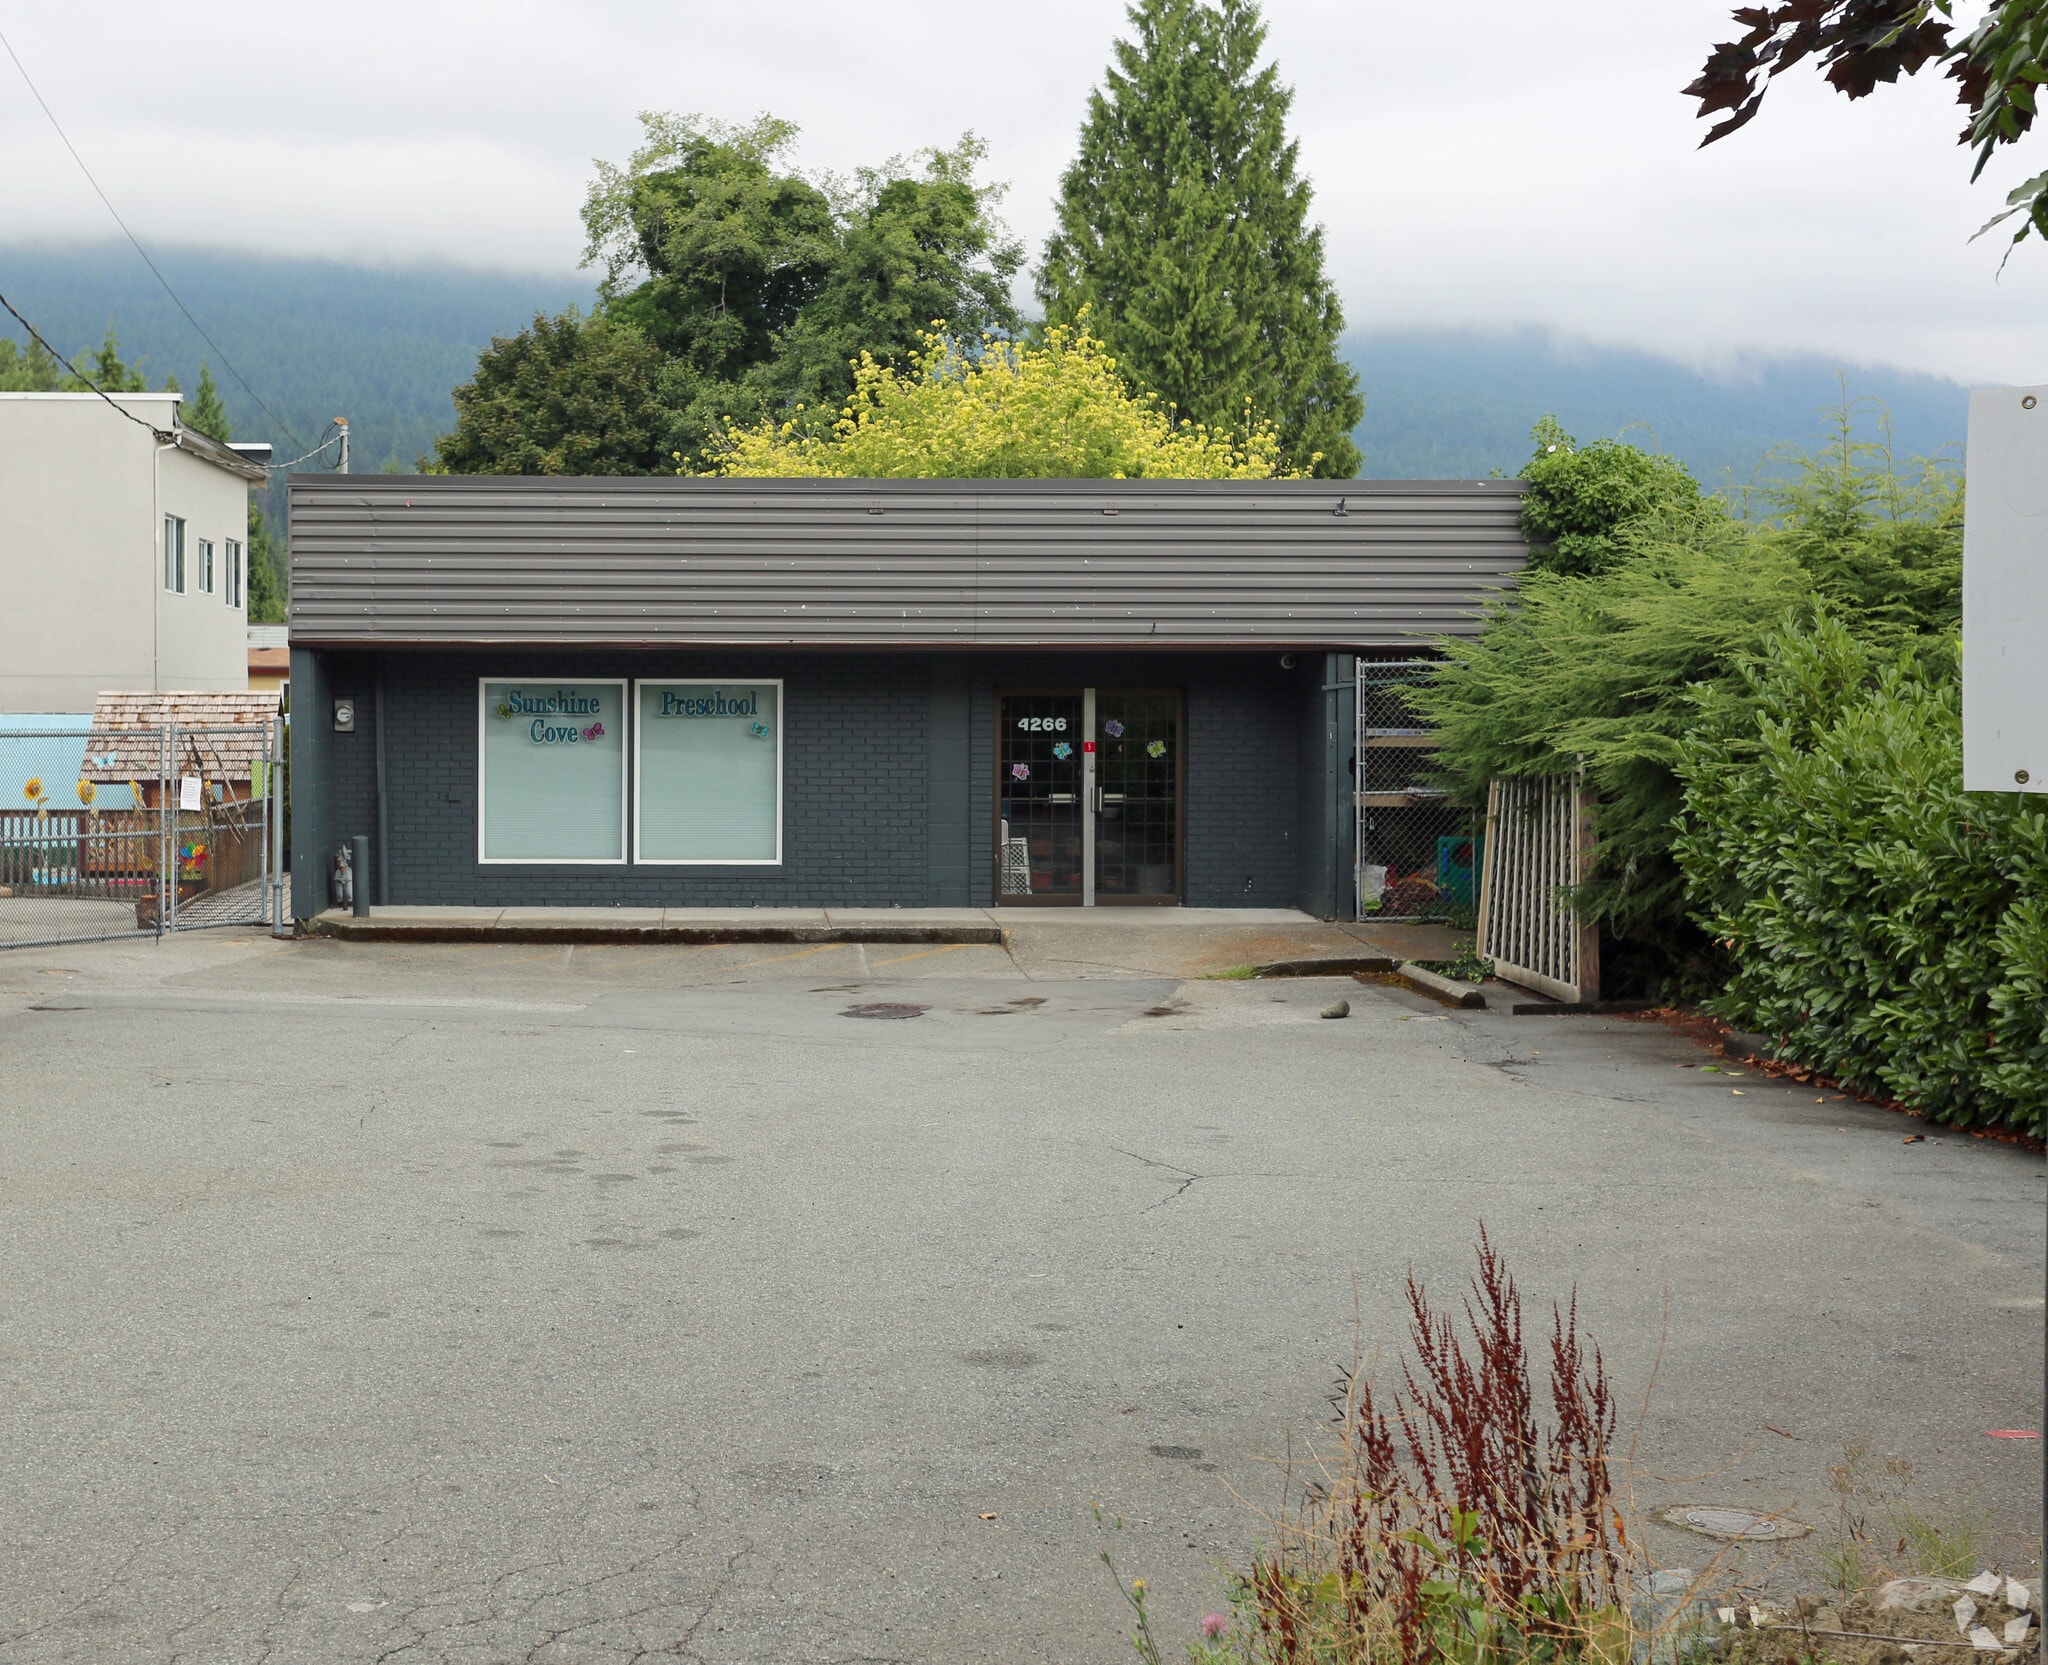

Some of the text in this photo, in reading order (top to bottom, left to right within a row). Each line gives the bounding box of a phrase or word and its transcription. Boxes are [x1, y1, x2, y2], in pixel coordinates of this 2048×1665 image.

[509, 690, 600, 714] Sunshine
[661, 691, 758, 715] Preschool
[530, 719, 578, 743] Cove
[1018, 717, 1067, 731] 4266
